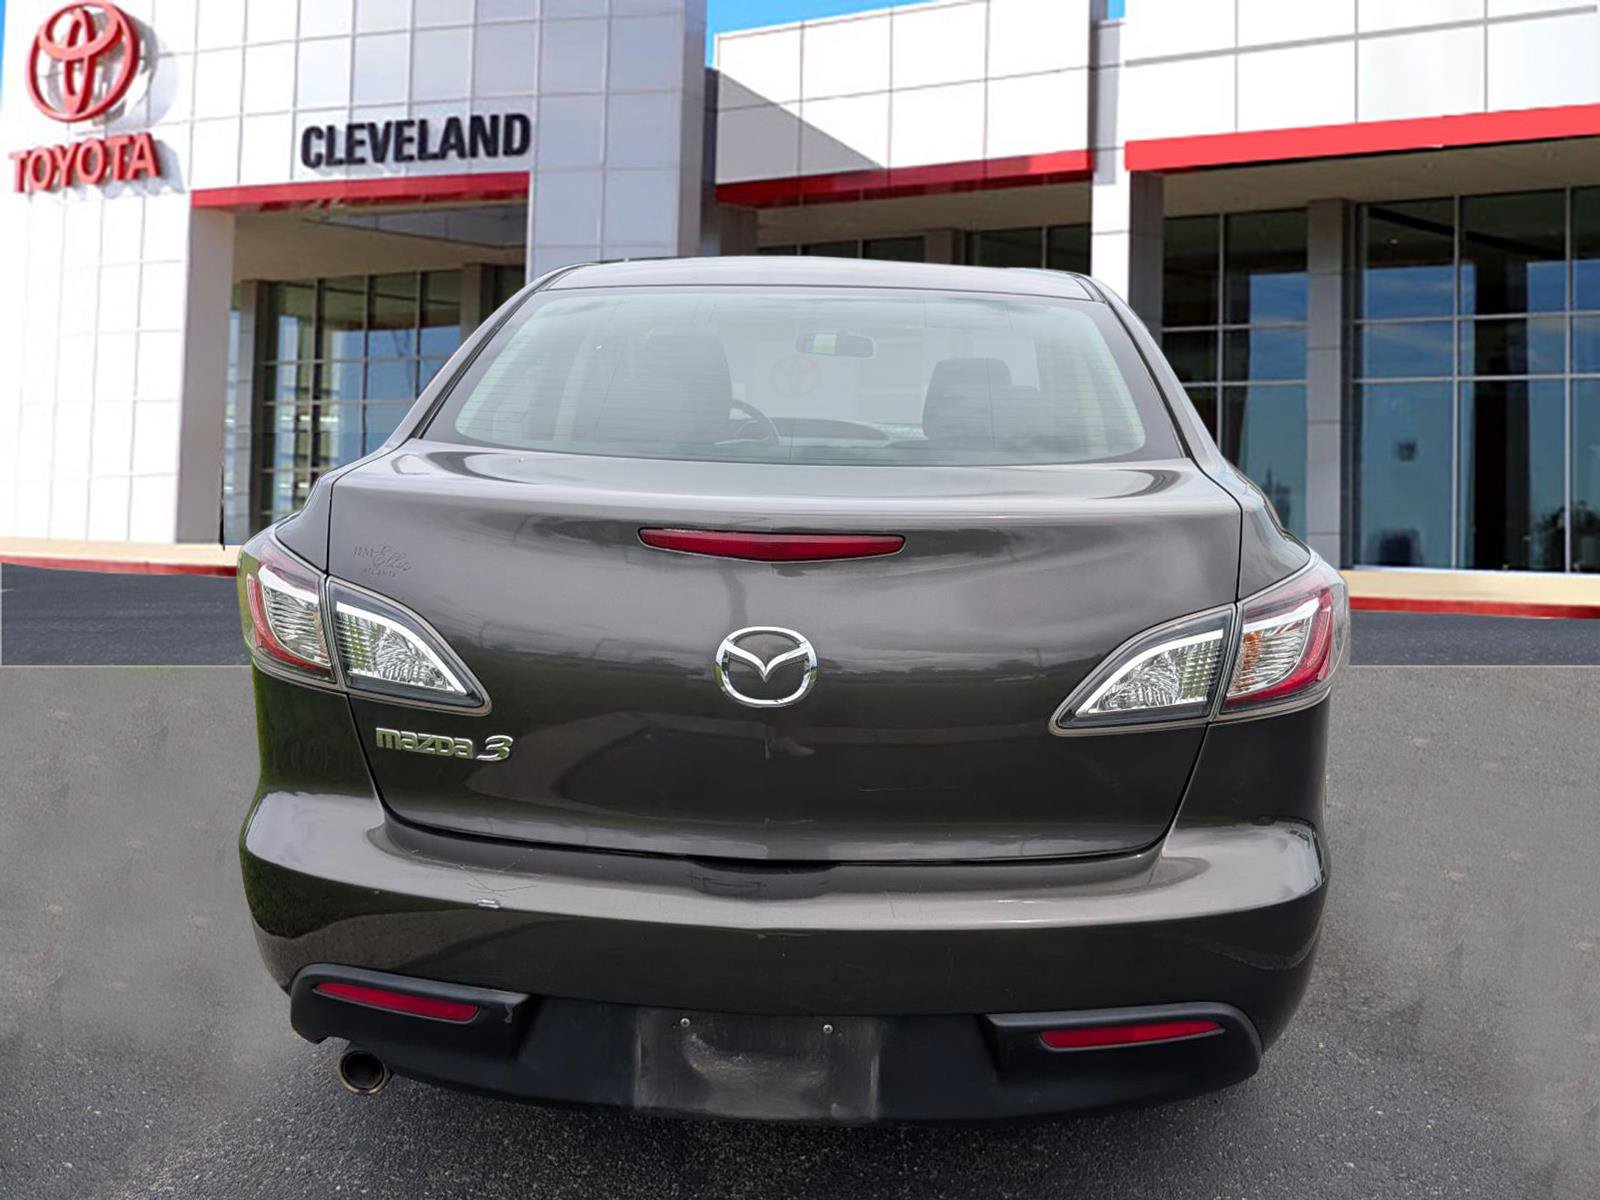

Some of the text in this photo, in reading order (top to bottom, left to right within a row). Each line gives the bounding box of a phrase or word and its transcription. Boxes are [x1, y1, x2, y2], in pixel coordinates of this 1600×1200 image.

[10, 132, 160, 194] TOYOTA
[301, 113, 531, 169] CLEVELAND
[475, 734, 514, 761] 3
